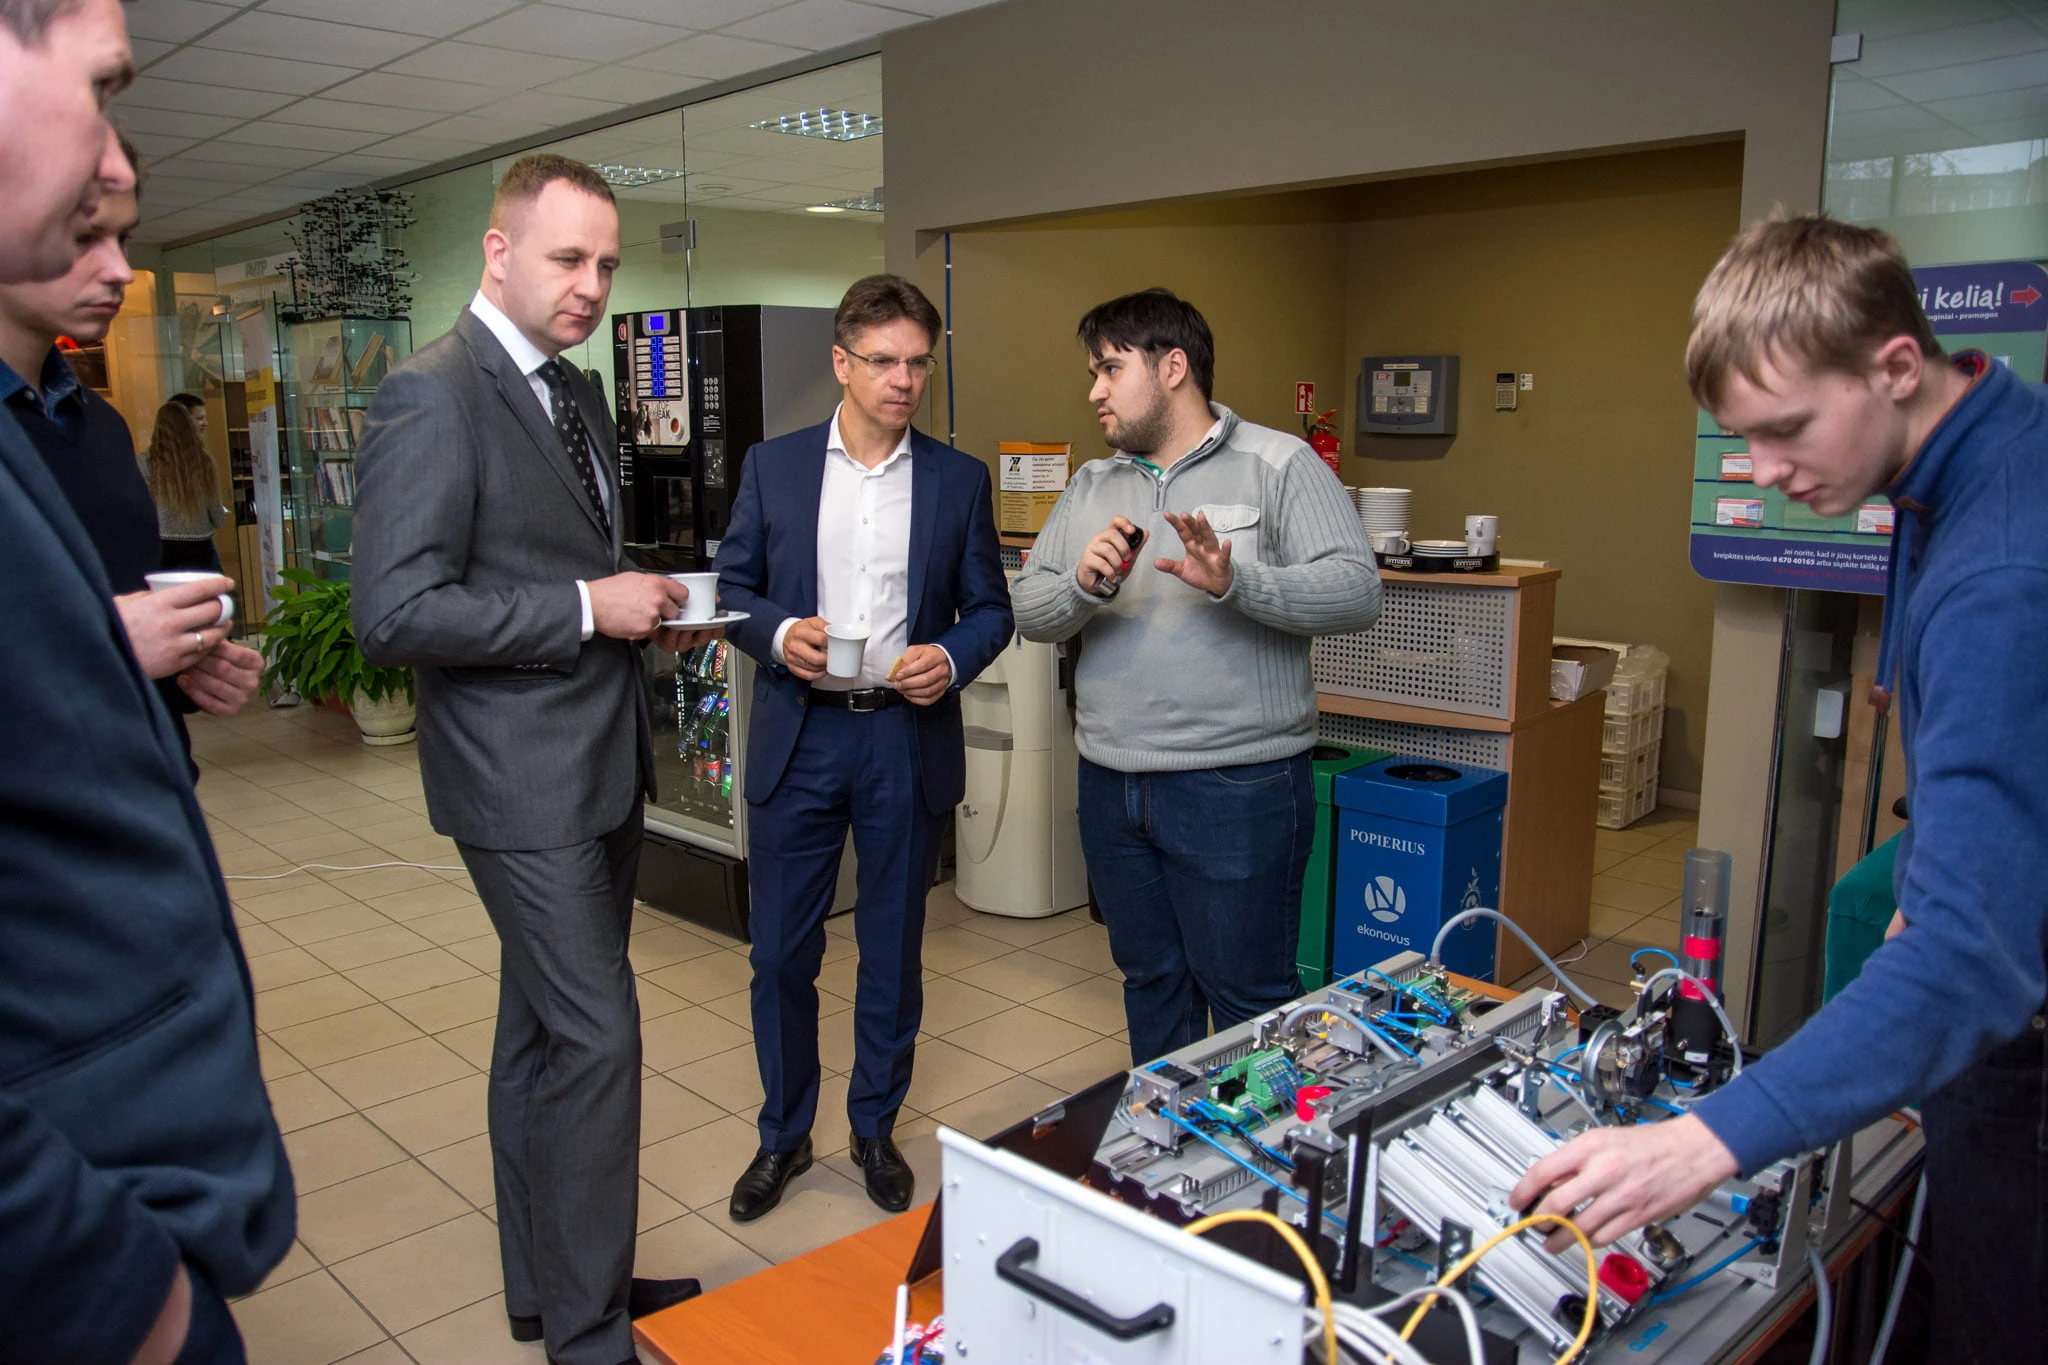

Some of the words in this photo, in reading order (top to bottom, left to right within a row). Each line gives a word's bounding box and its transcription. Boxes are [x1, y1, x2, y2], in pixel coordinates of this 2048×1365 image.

[1934, 282, 2004, 310] kelią!
[1778, 556, 1792, 564] 670
[1793, 557, 1816, 565] 40165
[1817, 550, 1830, 558] kad
[1350, 828, 1425, 856] POPIERIUS
[1356, 923, 1411, 946] ekonovus
